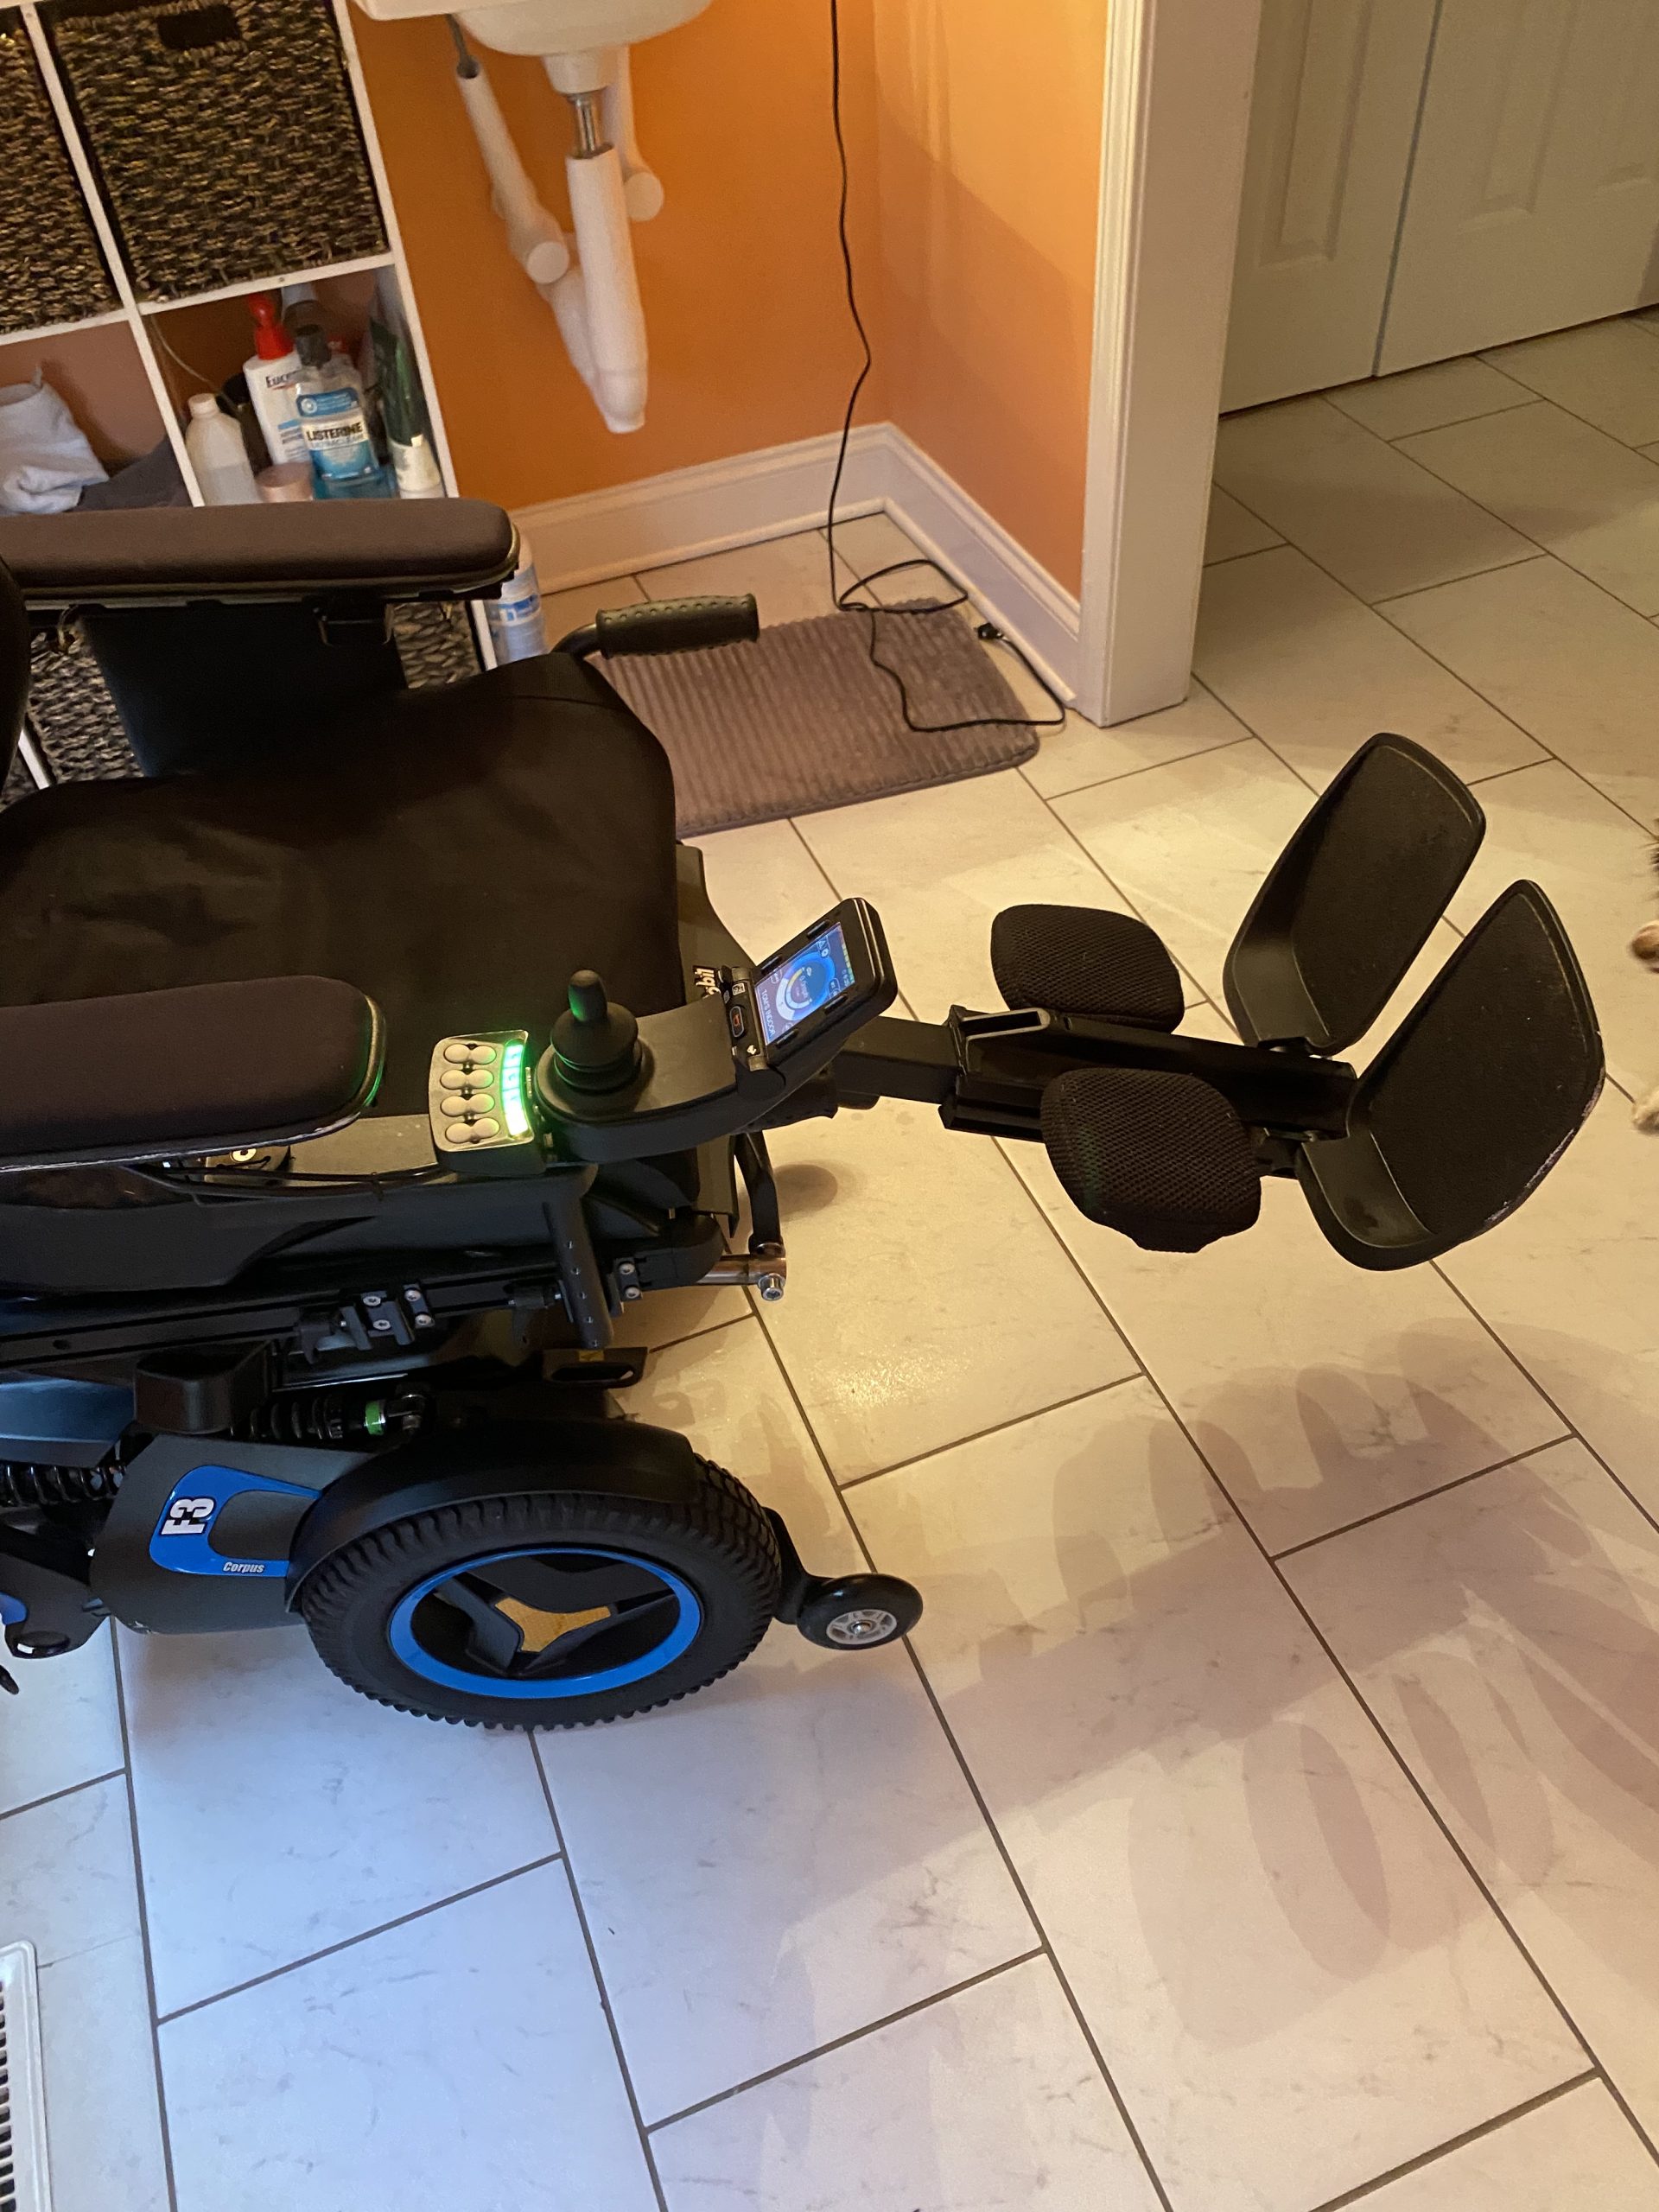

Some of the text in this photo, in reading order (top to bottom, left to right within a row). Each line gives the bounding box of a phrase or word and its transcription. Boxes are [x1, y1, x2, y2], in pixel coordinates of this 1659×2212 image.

[305, 421, 364, 442] LISTERINE
[161, 1497, 215, 1535] F3
[222, 1561, 264, 1573] Corpus
